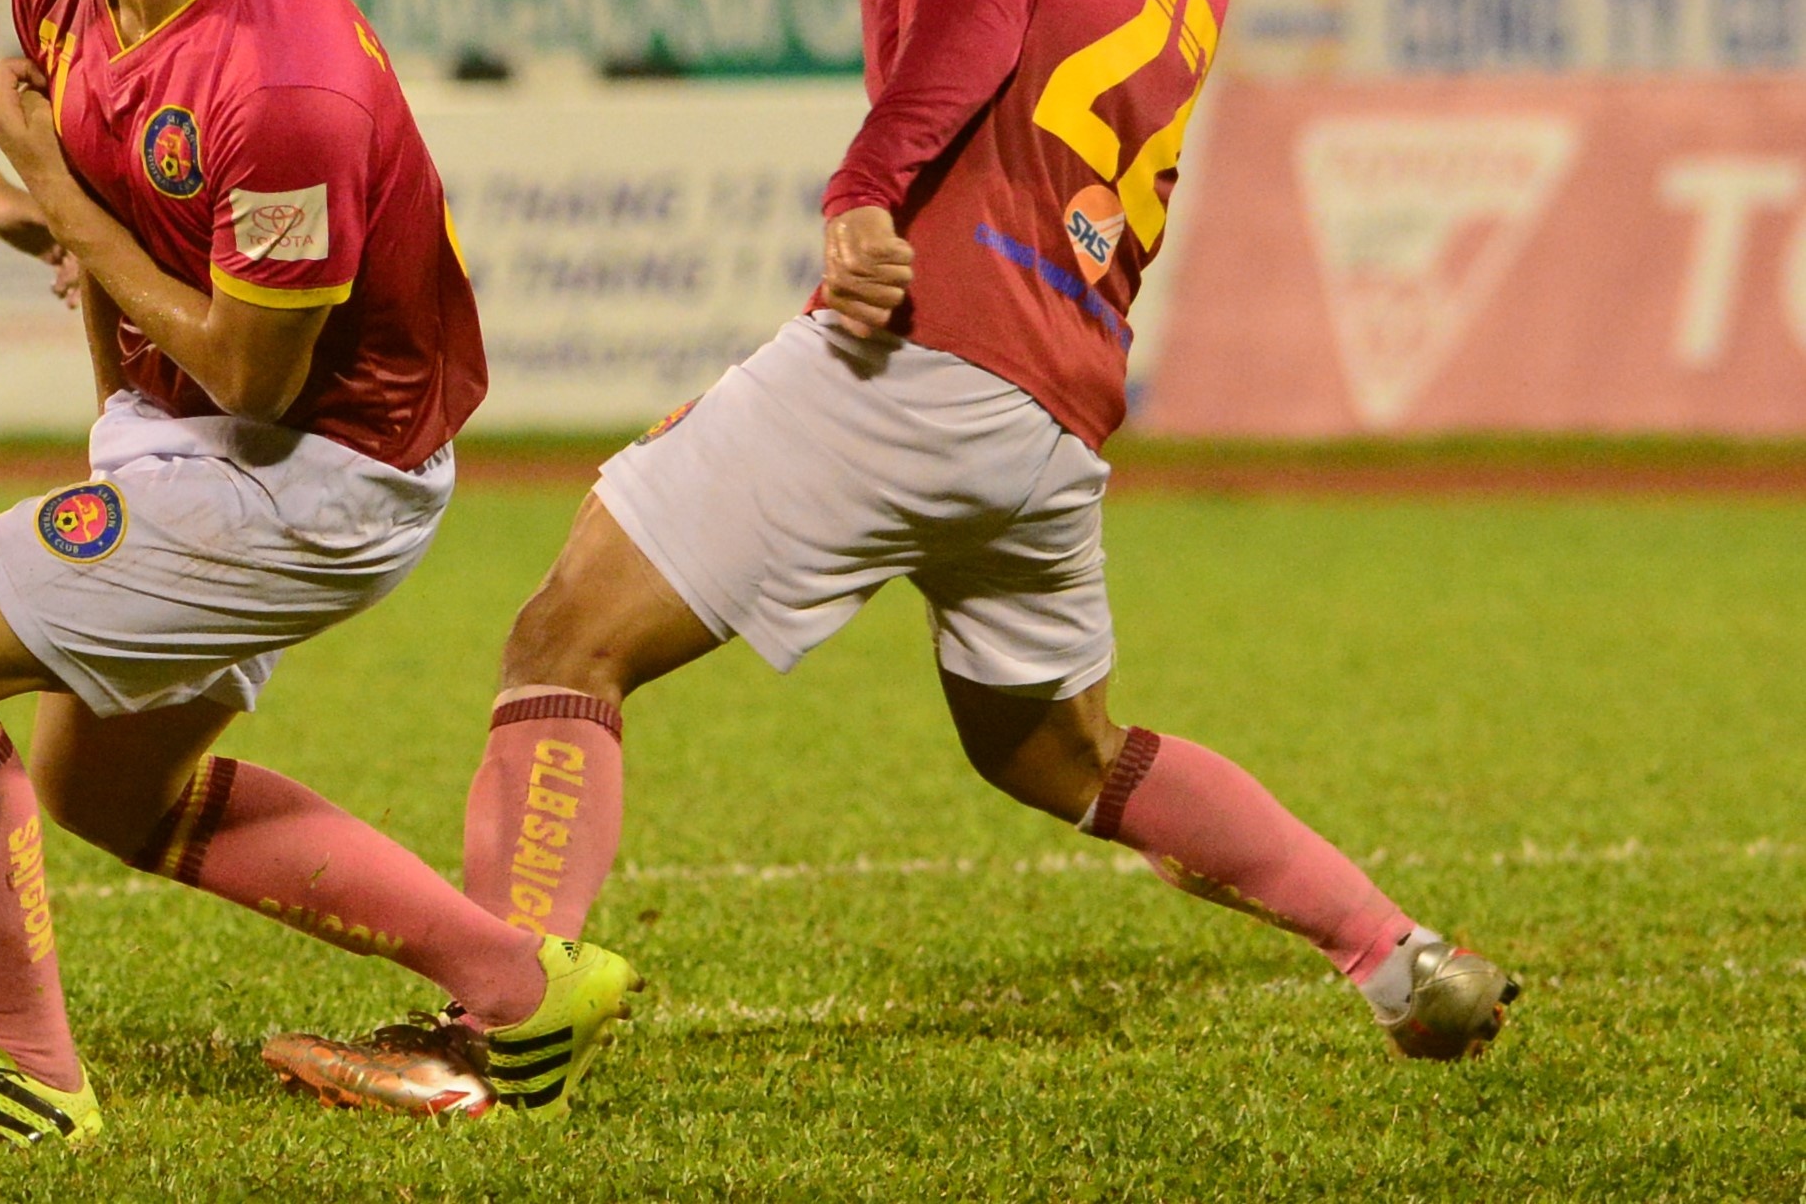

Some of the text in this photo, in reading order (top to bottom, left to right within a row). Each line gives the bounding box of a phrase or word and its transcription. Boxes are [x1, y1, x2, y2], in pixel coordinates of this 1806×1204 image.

[247, 233, 313, 248] TOOTA
[1066, 210, 1111, 264] SHS
[8, 814, 55, 964] SAIGON
